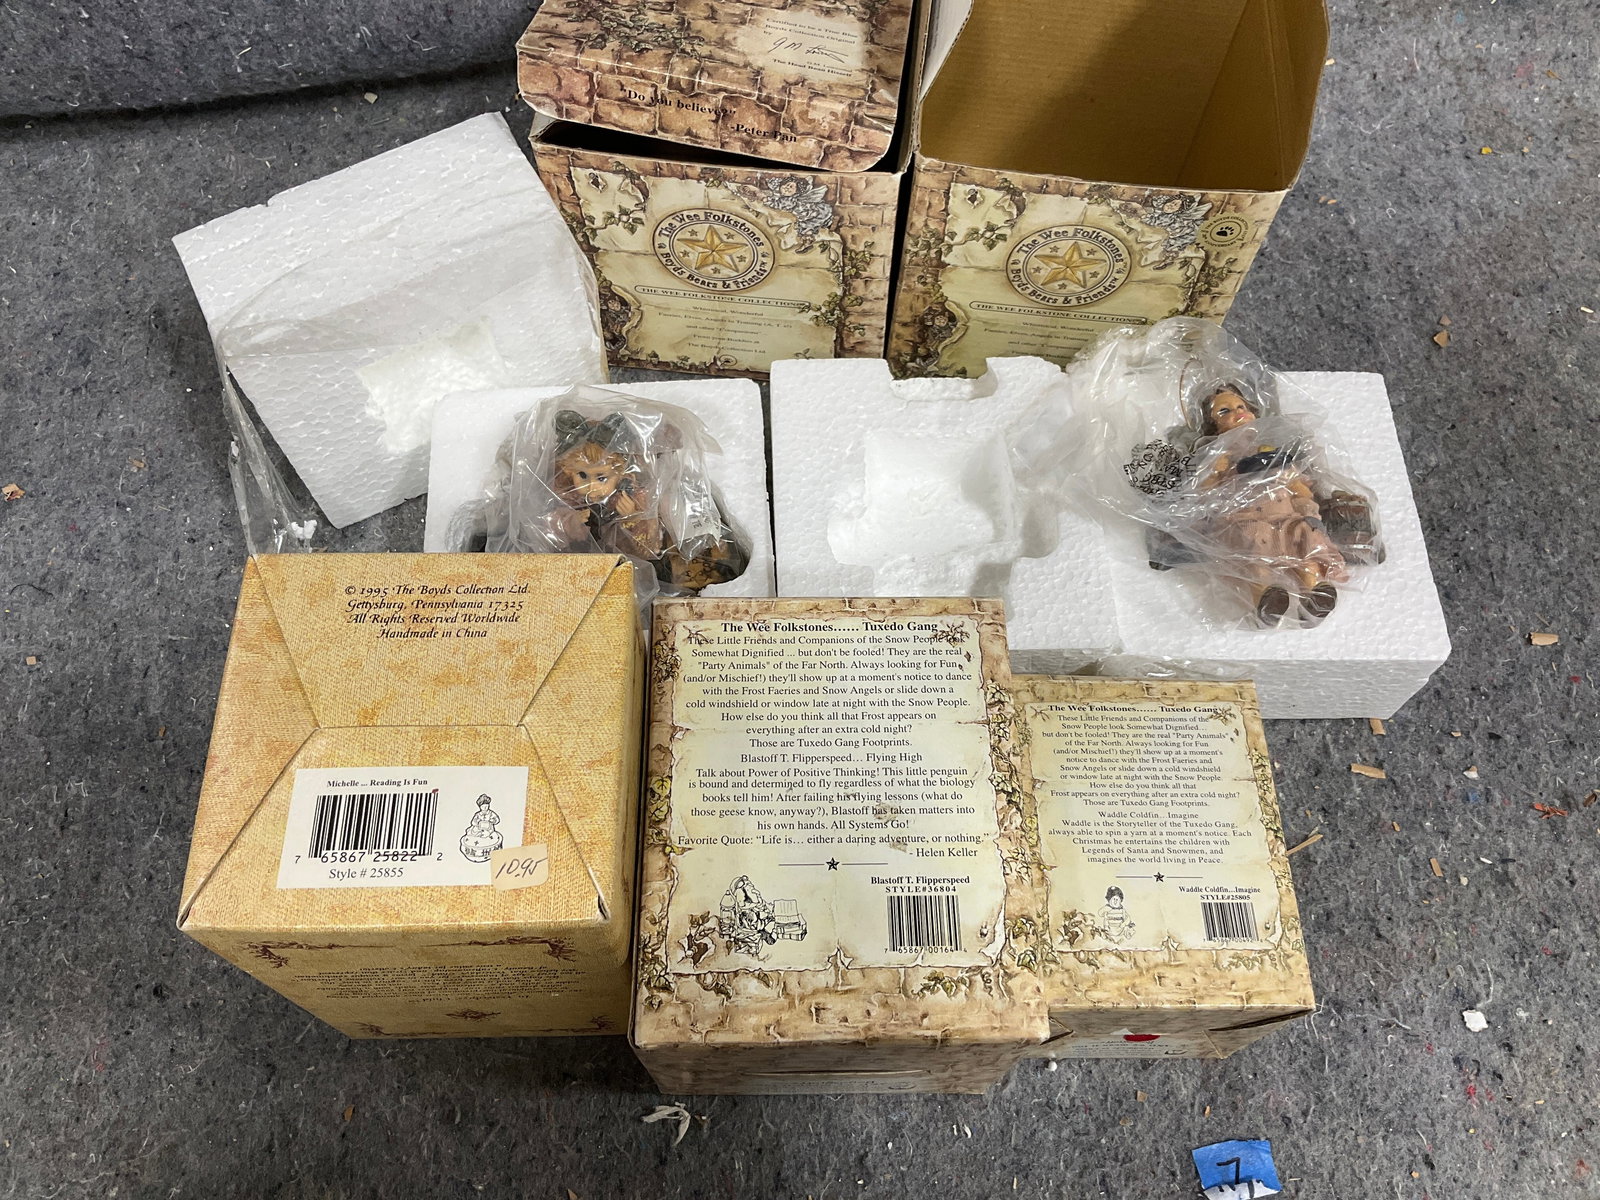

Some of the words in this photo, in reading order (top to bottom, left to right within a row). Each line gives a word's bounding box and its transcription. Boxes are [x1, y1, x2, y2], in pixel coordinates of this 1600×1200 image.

[731, 124, 770, 137] -Peter
[773, 130, 797, 142] Pan
[658, 222, 677, 238] The
[672, 212, 700, 226] Wee
[703, 212, 765, 247] Folkstones
[1017, 239, 1040, 254] The
[1038, 229, 1069, 240] Wee
[1072, 227, 1124, 263] Folkstones
[661, 252, 686, 276] Boyds
[686, 273, 718, 288] Bears
[722, 280, 731, 289] &
[1011, 268, 1030, 292] Boyds
[1028, 289, 1058, 304] Bears
[1062, 296, 1072, 304] &
[360, 587, 388, 598] 1995
[392, 585, 414, 595] The
[417, 584, 451, 598] Boyds
[456, 585, 504, 595] Collection
[508, 583, 530, 594] Ltd.
[346, 600, 407, 612] Gettysburg,
[411, 600, 483, 612] Pennsylvania
[488, 601, 523, 611] 17325
[347, 613, 366, 624] All
[368, 613, 405, 626] Rights
[409, 613, 457, 624] Reserved
[461, 613, 520, 623] Worldwide
[376, 628, 438, 639] Handmade
[442, 629, 452, 638] in
[456, 628, 487, 638] China
[720, 624, 743, 632] The
[746, 623, 770, 632] Wee
[863, 622, 903, 631] Tuxedo
[906, 622, 938, 633] Gang
[1193, 705, 1218, 714] Gang
[721, 713, 743, 721] How
[745, 712, 764, 721] else
[766, 712, 778, 721] do
[780, 714, 797, 723] you
[800, 712, 824, 720] think
[826, 712, 838, 720] all
[841, 712, 858, 720] that
[861, 711, 884, 720] Frost
[887, 713, 922, 722] appears
[745, 725, 795, 736] everything
[797, 725, 819, 734] after
[834, 725, 858, 733] extra
[860, 724, 880, 733] cold
[883, 724, 912, 735] night?
[748, 739, 777, 748] Those
[798, 738, 832, 747] Tuxedo
[834, 738, 859, 749] Gang
[862, 738, 912, 749] Footprints.
[740, 754, 776, 763] Blastoff
[779, 754, 790, 762] T.
[866, 753, 896, 764] Flying
[899, 753, 922, 764] High
[370, 779, 401, 788] Reading
[1148, 799, 1169, 808] Gang
[1170, 799, 1210, 808] Footprints.
[757, 821, 771, 830] his
[797, 821, 827, 830] hands.
[830, 821, 845, 829] All
[848, 820, 889, 831] Systems
[890, 820, 909, 829] Go!
[1116, 820, 1156, 829] Storyteller
[1214, 821, 1237, 829] Gang,
[678, 836, 717, 845] Favorite
[720, 836, 752, 844] Quote:
[806, 835, 834, 844] either
[845, 835, 876, 846] daring
[878, 834, 928, 845] adventure,
[294, 855, 301, 864] 7
[321, 851, 364, 864] 65867
[373, 850, 418, 862] 25822
[437, 853, 443, 861] 2
[916, 848, 944, 857] Helen
[947, 848, 977, 857] Keller
[1081, 846, 1114, 855] Legends
[1166, 847, 1207, 856] Snowmen,
[1087, 855, 1122, 864] imagines
[1162, 856, 1186, 865] living
[329, 868, 357, 879] Style
[360, 869, 367, 878] #
[370, 867, 404, 878] 25855
[495, 858, 548, 879] 10.95
[871, 876, 904, 884] Blastoff
[916, 876, 970, 886] Flipperspeed
